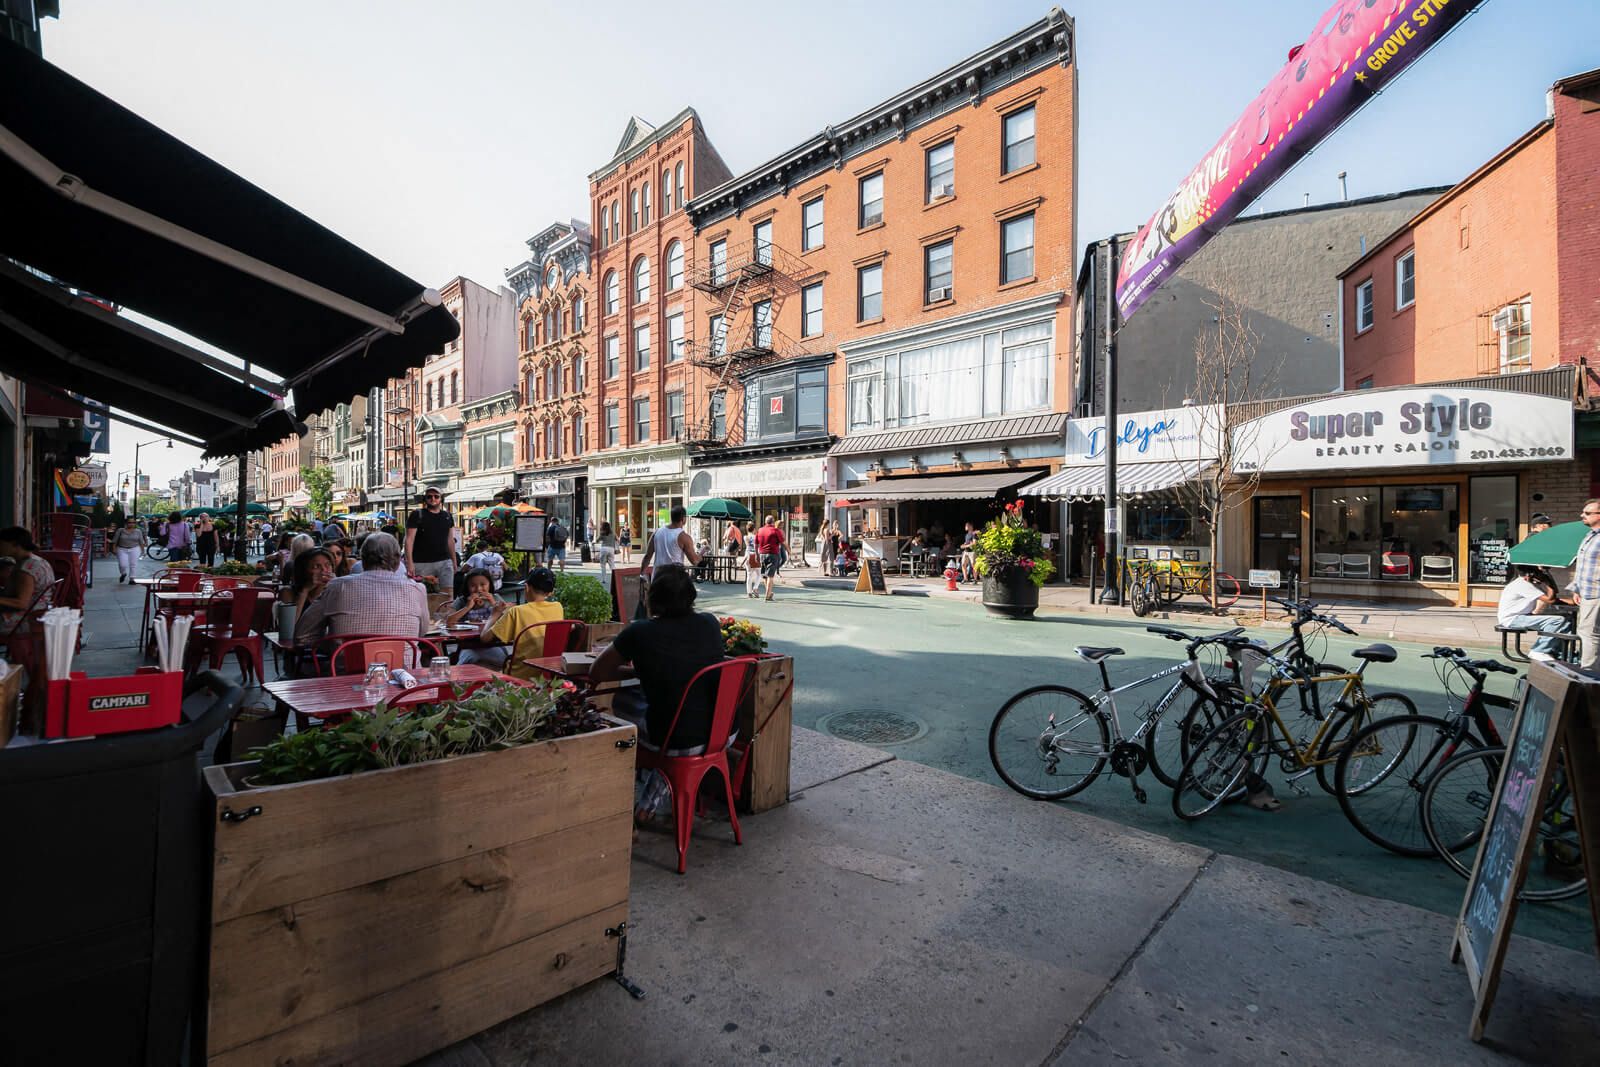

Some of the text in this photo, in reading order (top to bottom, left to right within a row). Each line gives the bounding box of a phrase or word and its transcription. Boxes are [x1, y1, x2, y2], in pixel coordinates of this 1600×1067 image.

[1366, 20, 1417, 71] GROVE
[1290, 397, 1493, 444] Super Style
[1315, 440, 1460, 457] BEAUTY SALON
[1470, 446, 1566, 460] 201.435.7869
[1239, 462, 1258, 470] 126
[92, 695, 147, 709] CAMPARI
